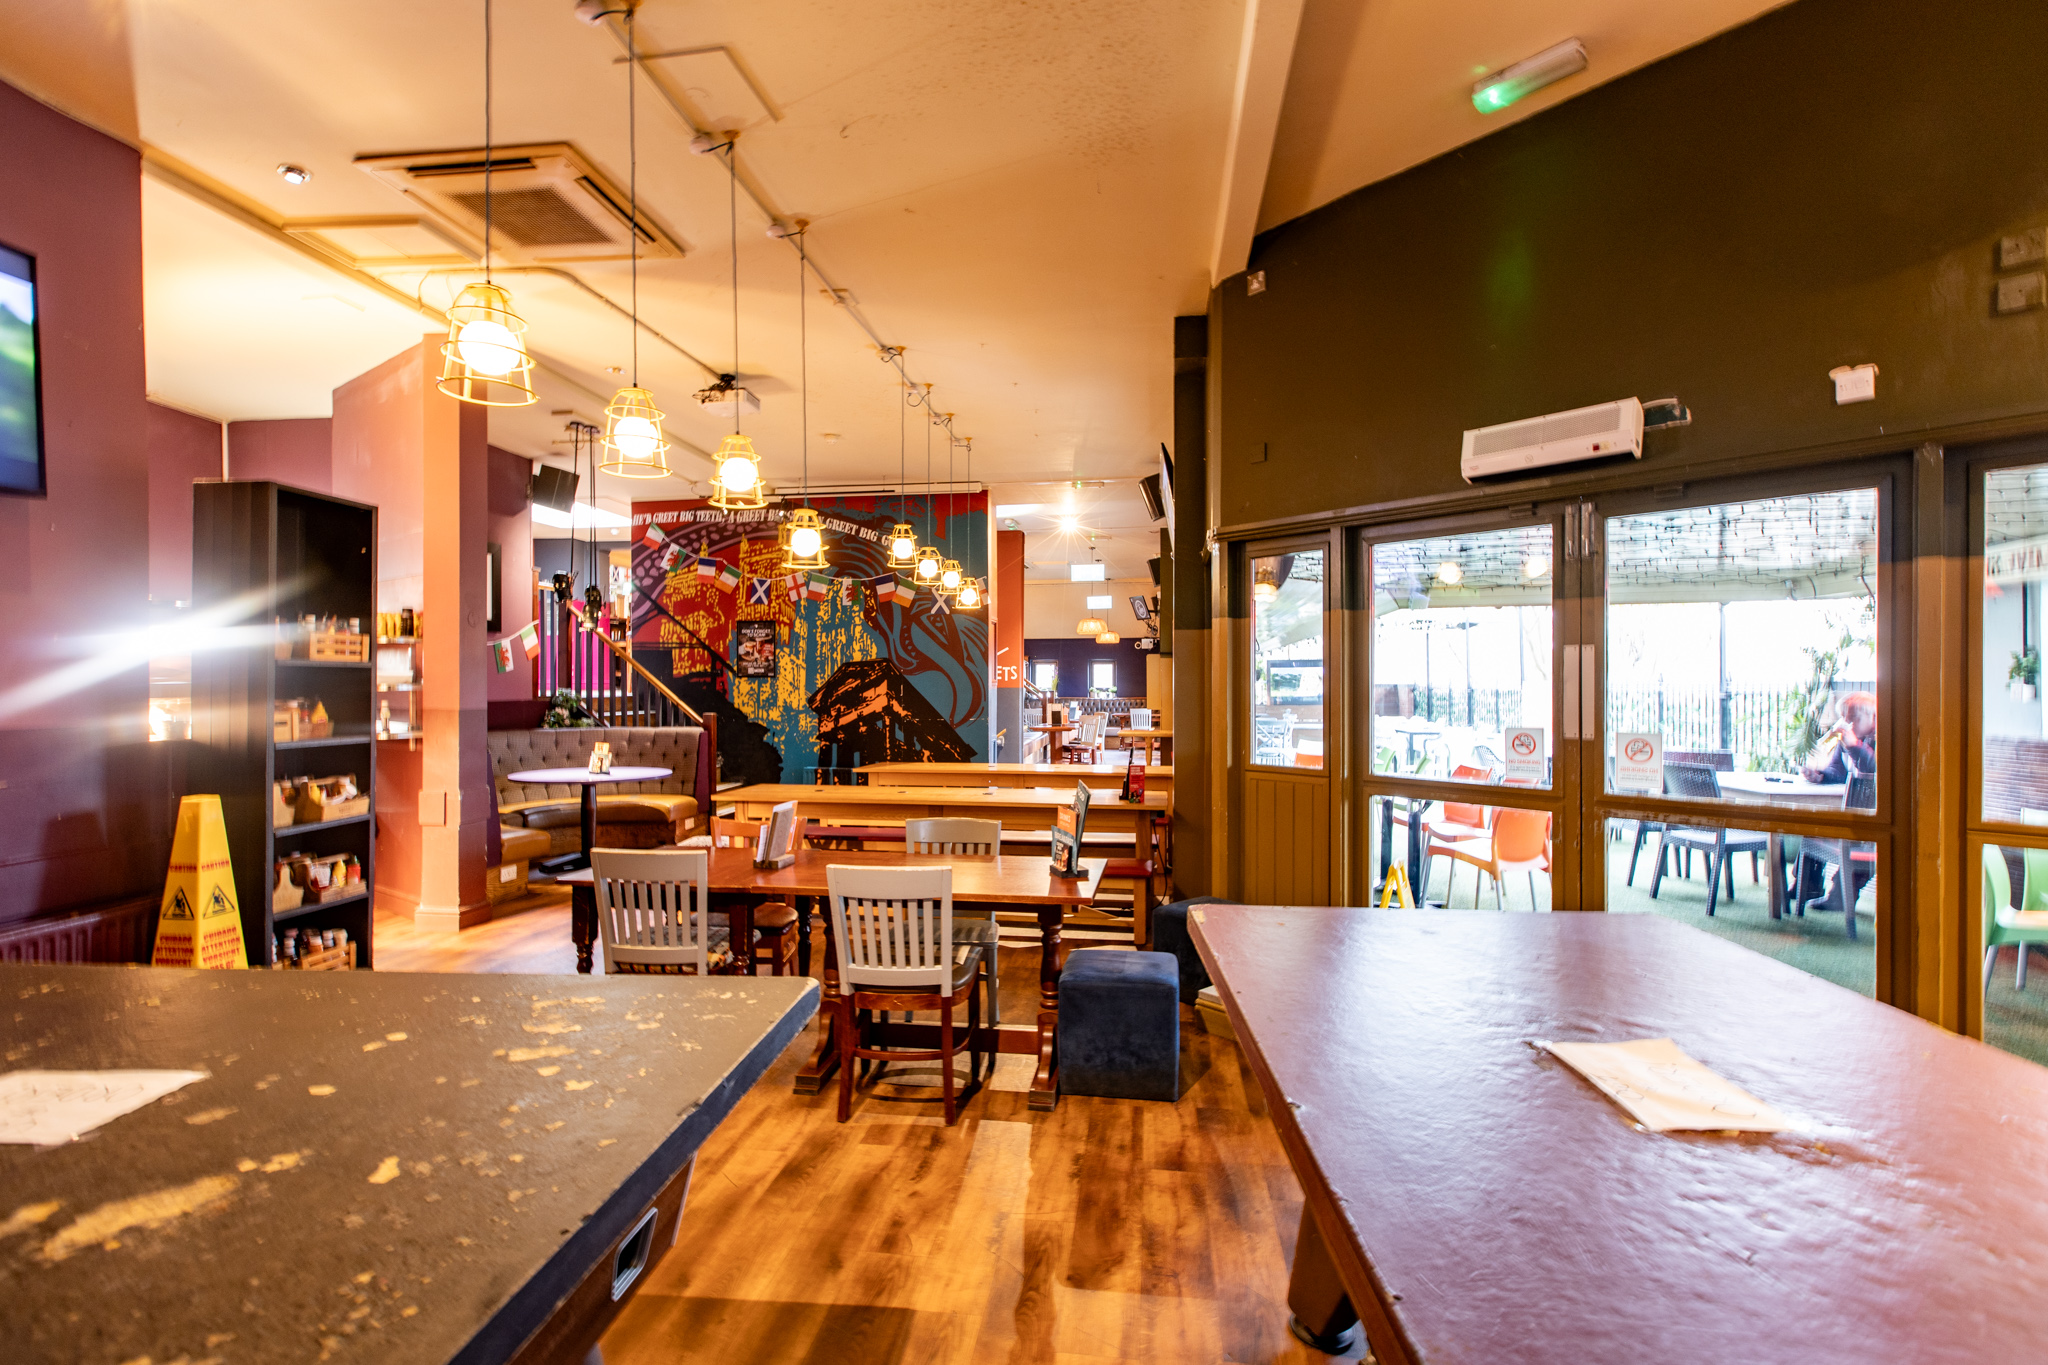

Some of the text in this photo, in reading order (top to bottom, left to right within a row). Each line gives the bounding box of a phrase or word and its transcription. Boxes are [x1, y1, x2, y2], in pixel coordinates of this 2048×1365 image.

[652, 511, 679, 523] GREET
[679, 510, 695, 522] BIG
[728, 510, 737, 524] A
[736, 509, 768, 523] GREET
[825, 518, 859, 536] GREET
[859, 527, 879, 542] BIG
[169, 863, 197, 873] CAUTION
[201, 860, 229, 872] CAUTION
